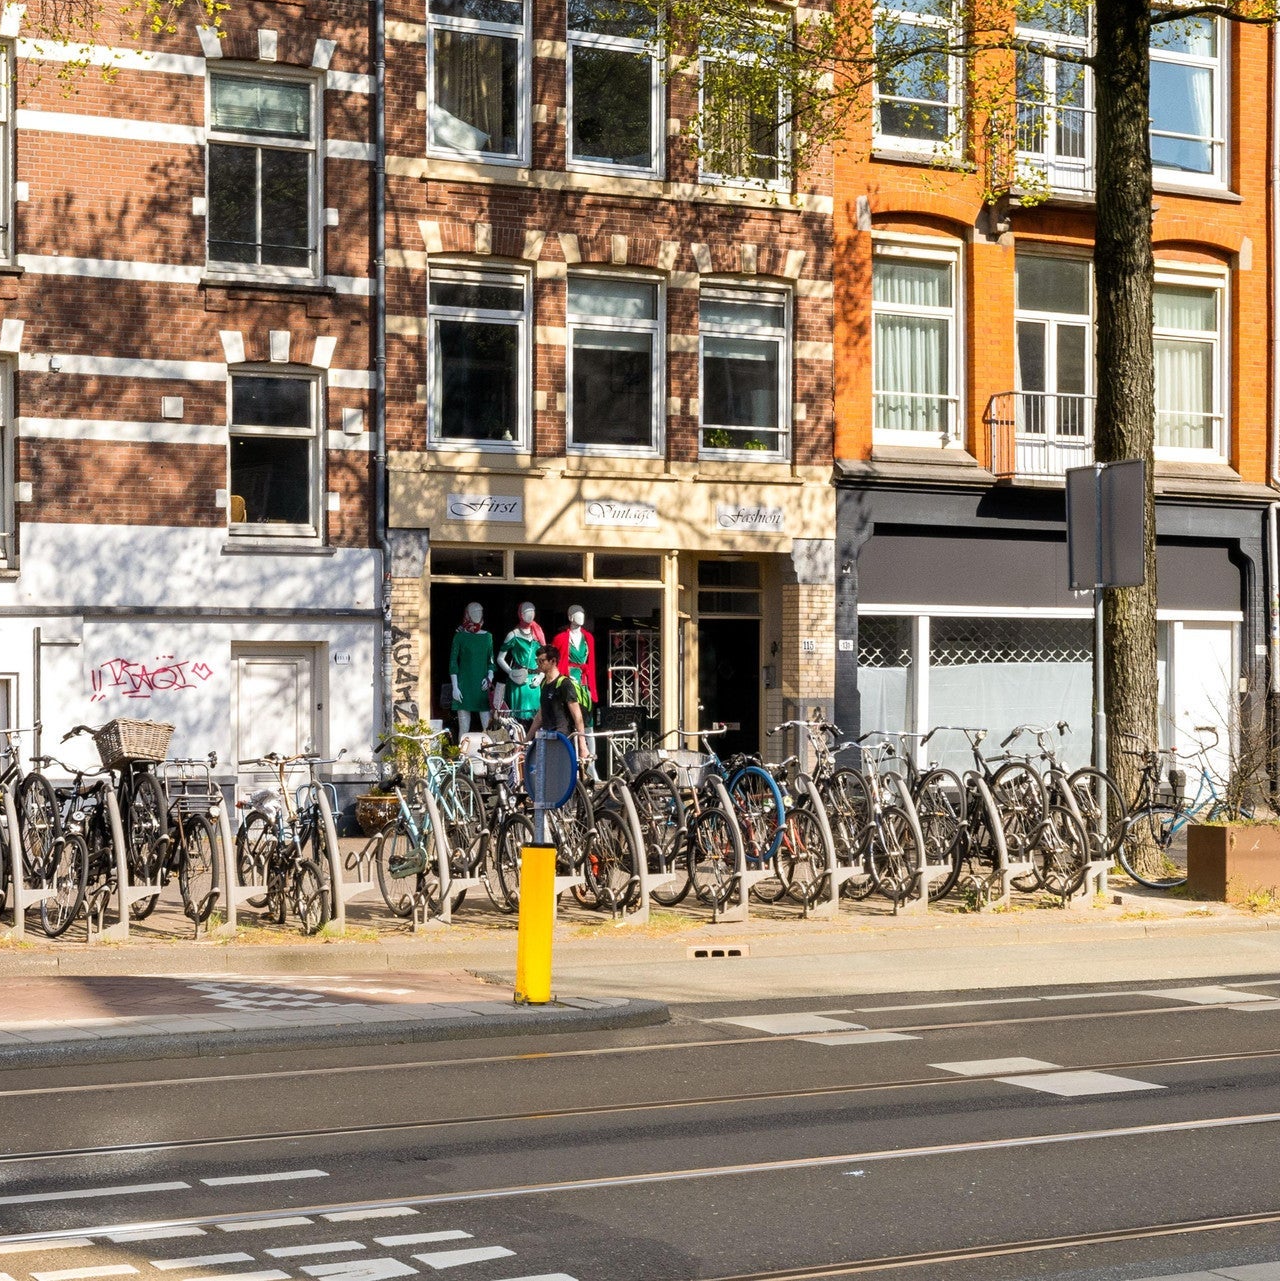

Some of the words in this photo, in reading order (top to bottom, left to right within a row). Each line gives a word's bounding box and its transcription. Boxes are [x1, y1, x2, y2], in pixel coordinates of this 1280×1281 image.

[450, 495, 519, 516] First
[587, 501, 655, 522] Vintage
[719, 508, 782, 527] Fashion
[803, 640, 815, 651] 115
